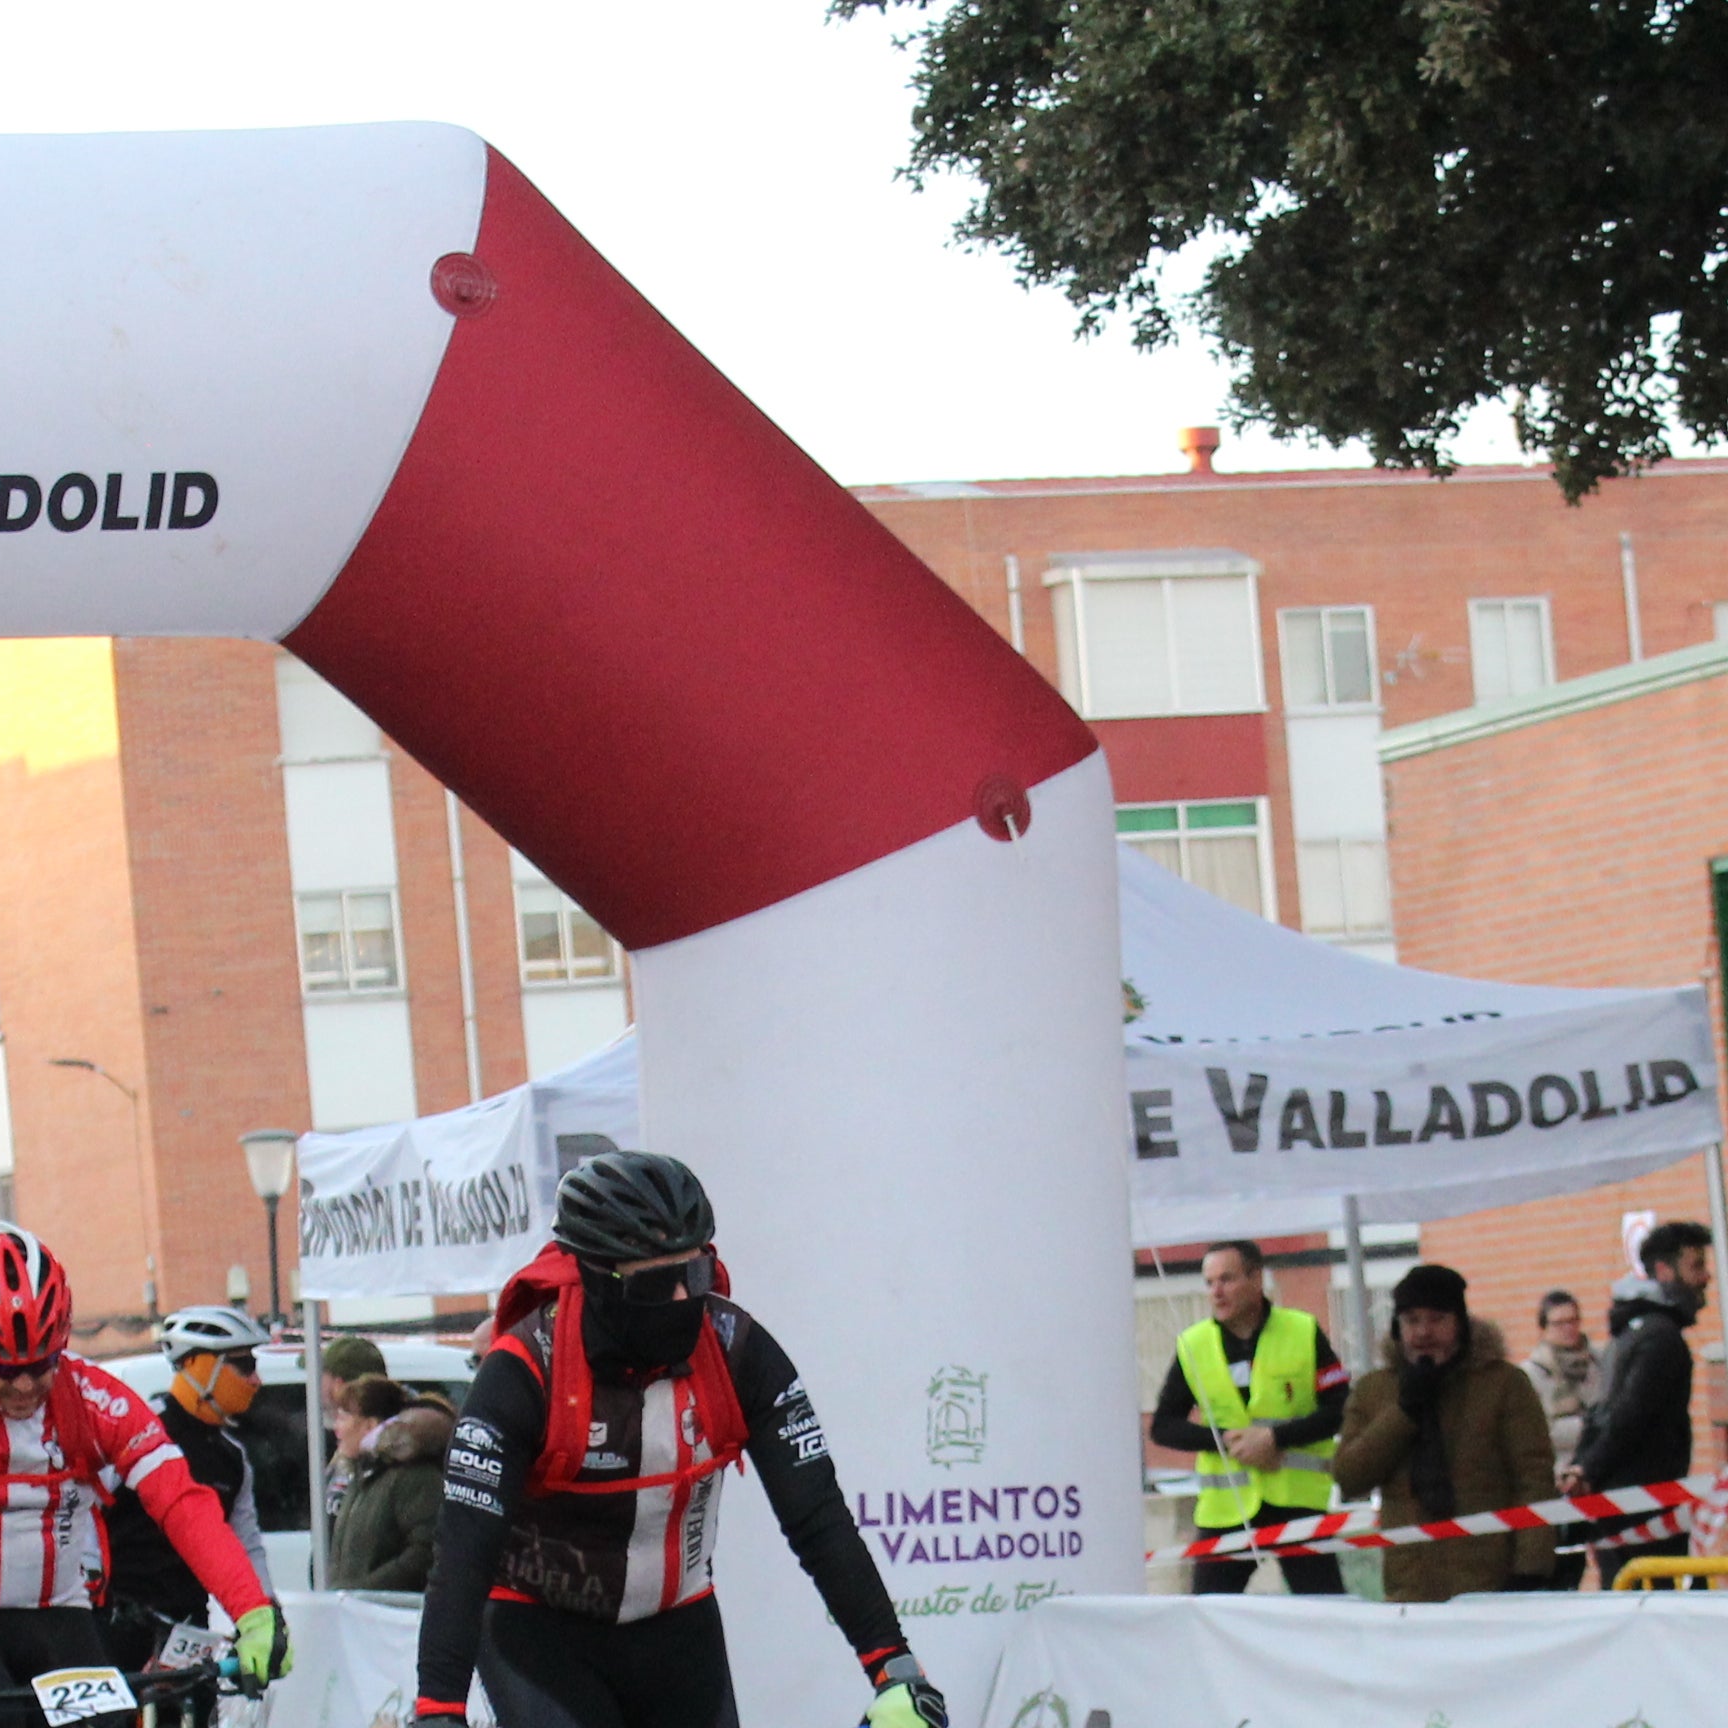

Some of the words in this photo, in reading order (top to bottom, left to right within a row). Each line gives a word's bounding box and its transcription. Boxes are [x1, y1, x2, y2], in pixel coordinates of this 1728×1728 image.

[1205, 1058, 1699, 1153] VALLADOLID
[858, 1485, 1081, 1527] LIMENTOS
[879, 1531, 1083, 1564] VALLADOLID
[52, 1680, 116, 1710] 224
